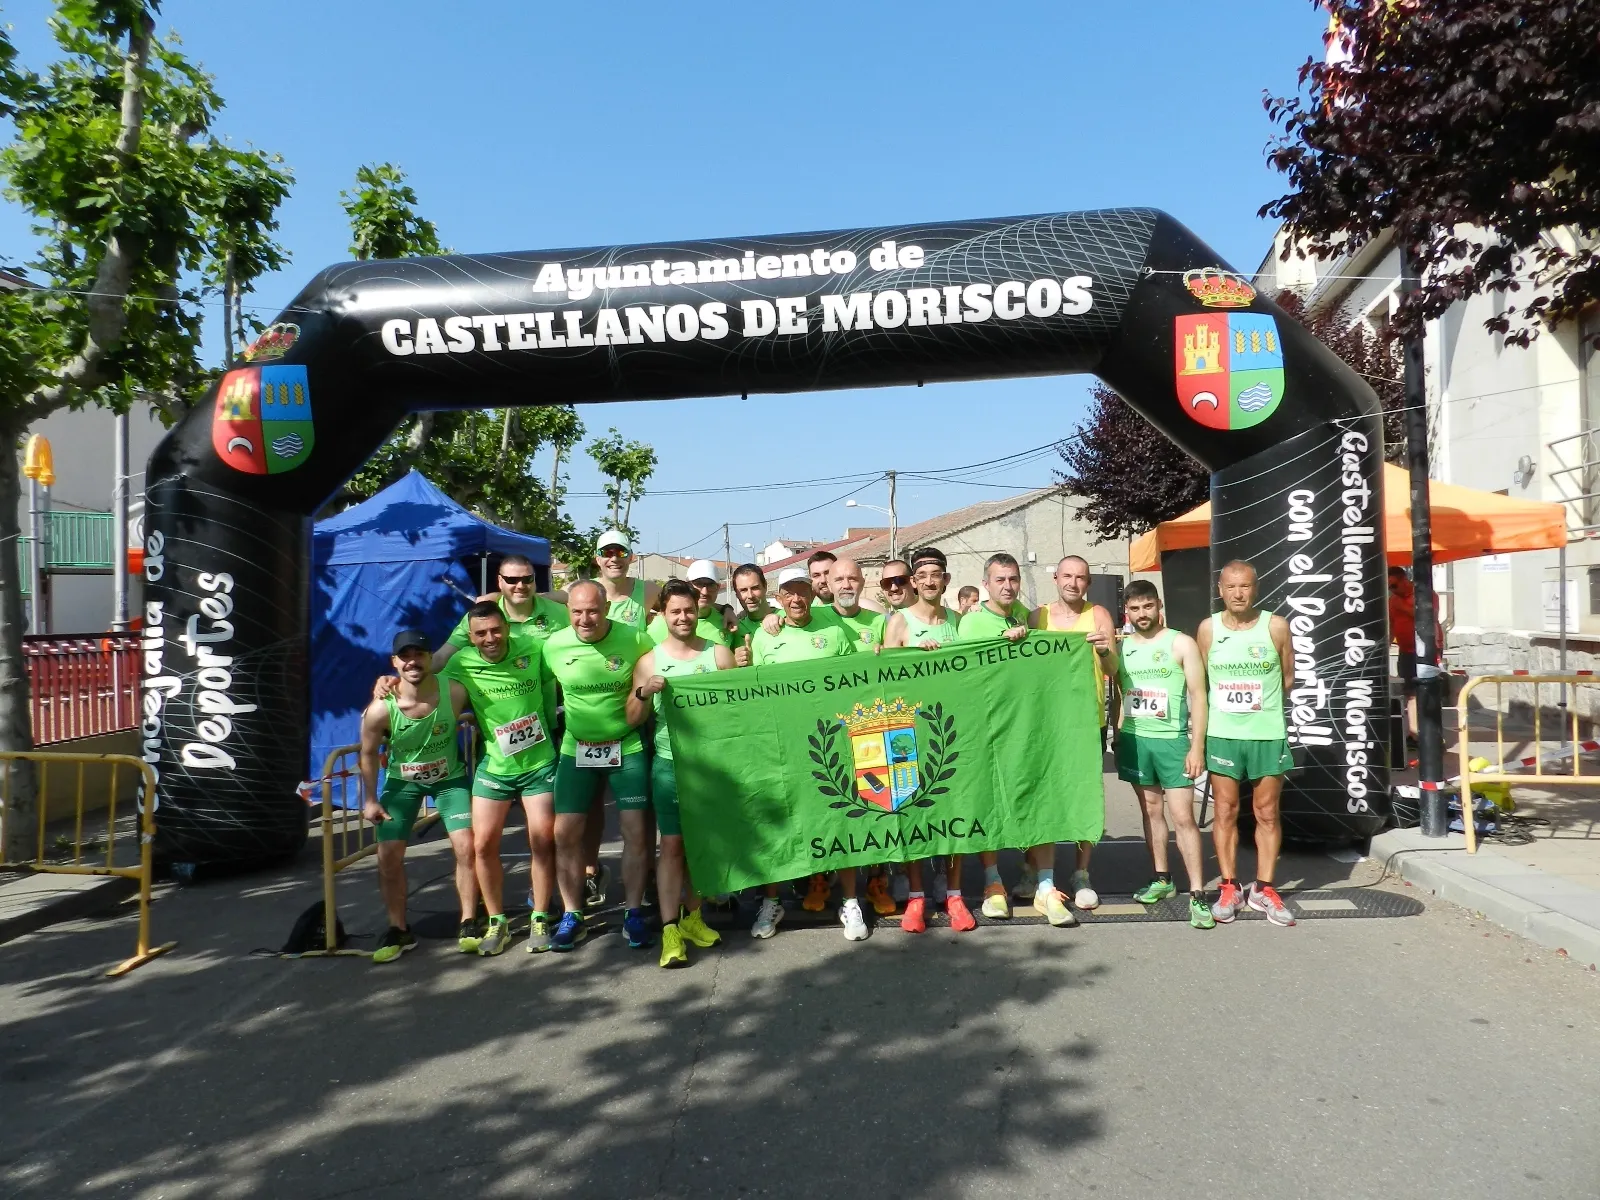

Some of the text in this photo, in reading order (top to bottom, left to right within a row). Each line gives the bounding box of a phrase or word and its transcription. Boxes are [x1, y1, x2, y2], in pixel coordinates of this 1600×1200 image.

[532, 240, 925, 300] Ayuntamiento de
[380, 275, 1094, 356] CASTELLANOS DE MORISCOS
[1287, 488, 1315, 542] con
[143, 529, 165, 582] de
[1288, 554, 1333, 584] el
[1341, 431, 1376, 815] Castellanos de Moriscos
[178, 572, 258, 770] Deportes
[673, 637, 1071, 709] CLUB RUNNING SAN MAXIMO TELECOM
[1132, 698, 1158, 710] 316
[1227, 692, 1253, 703] 403
[509, 727, 535, 745] 432
[585, 746, 611, 758] 439
[413, 768, 440, 780] 433
[810, 817, 987, 859] SALAMANCA
